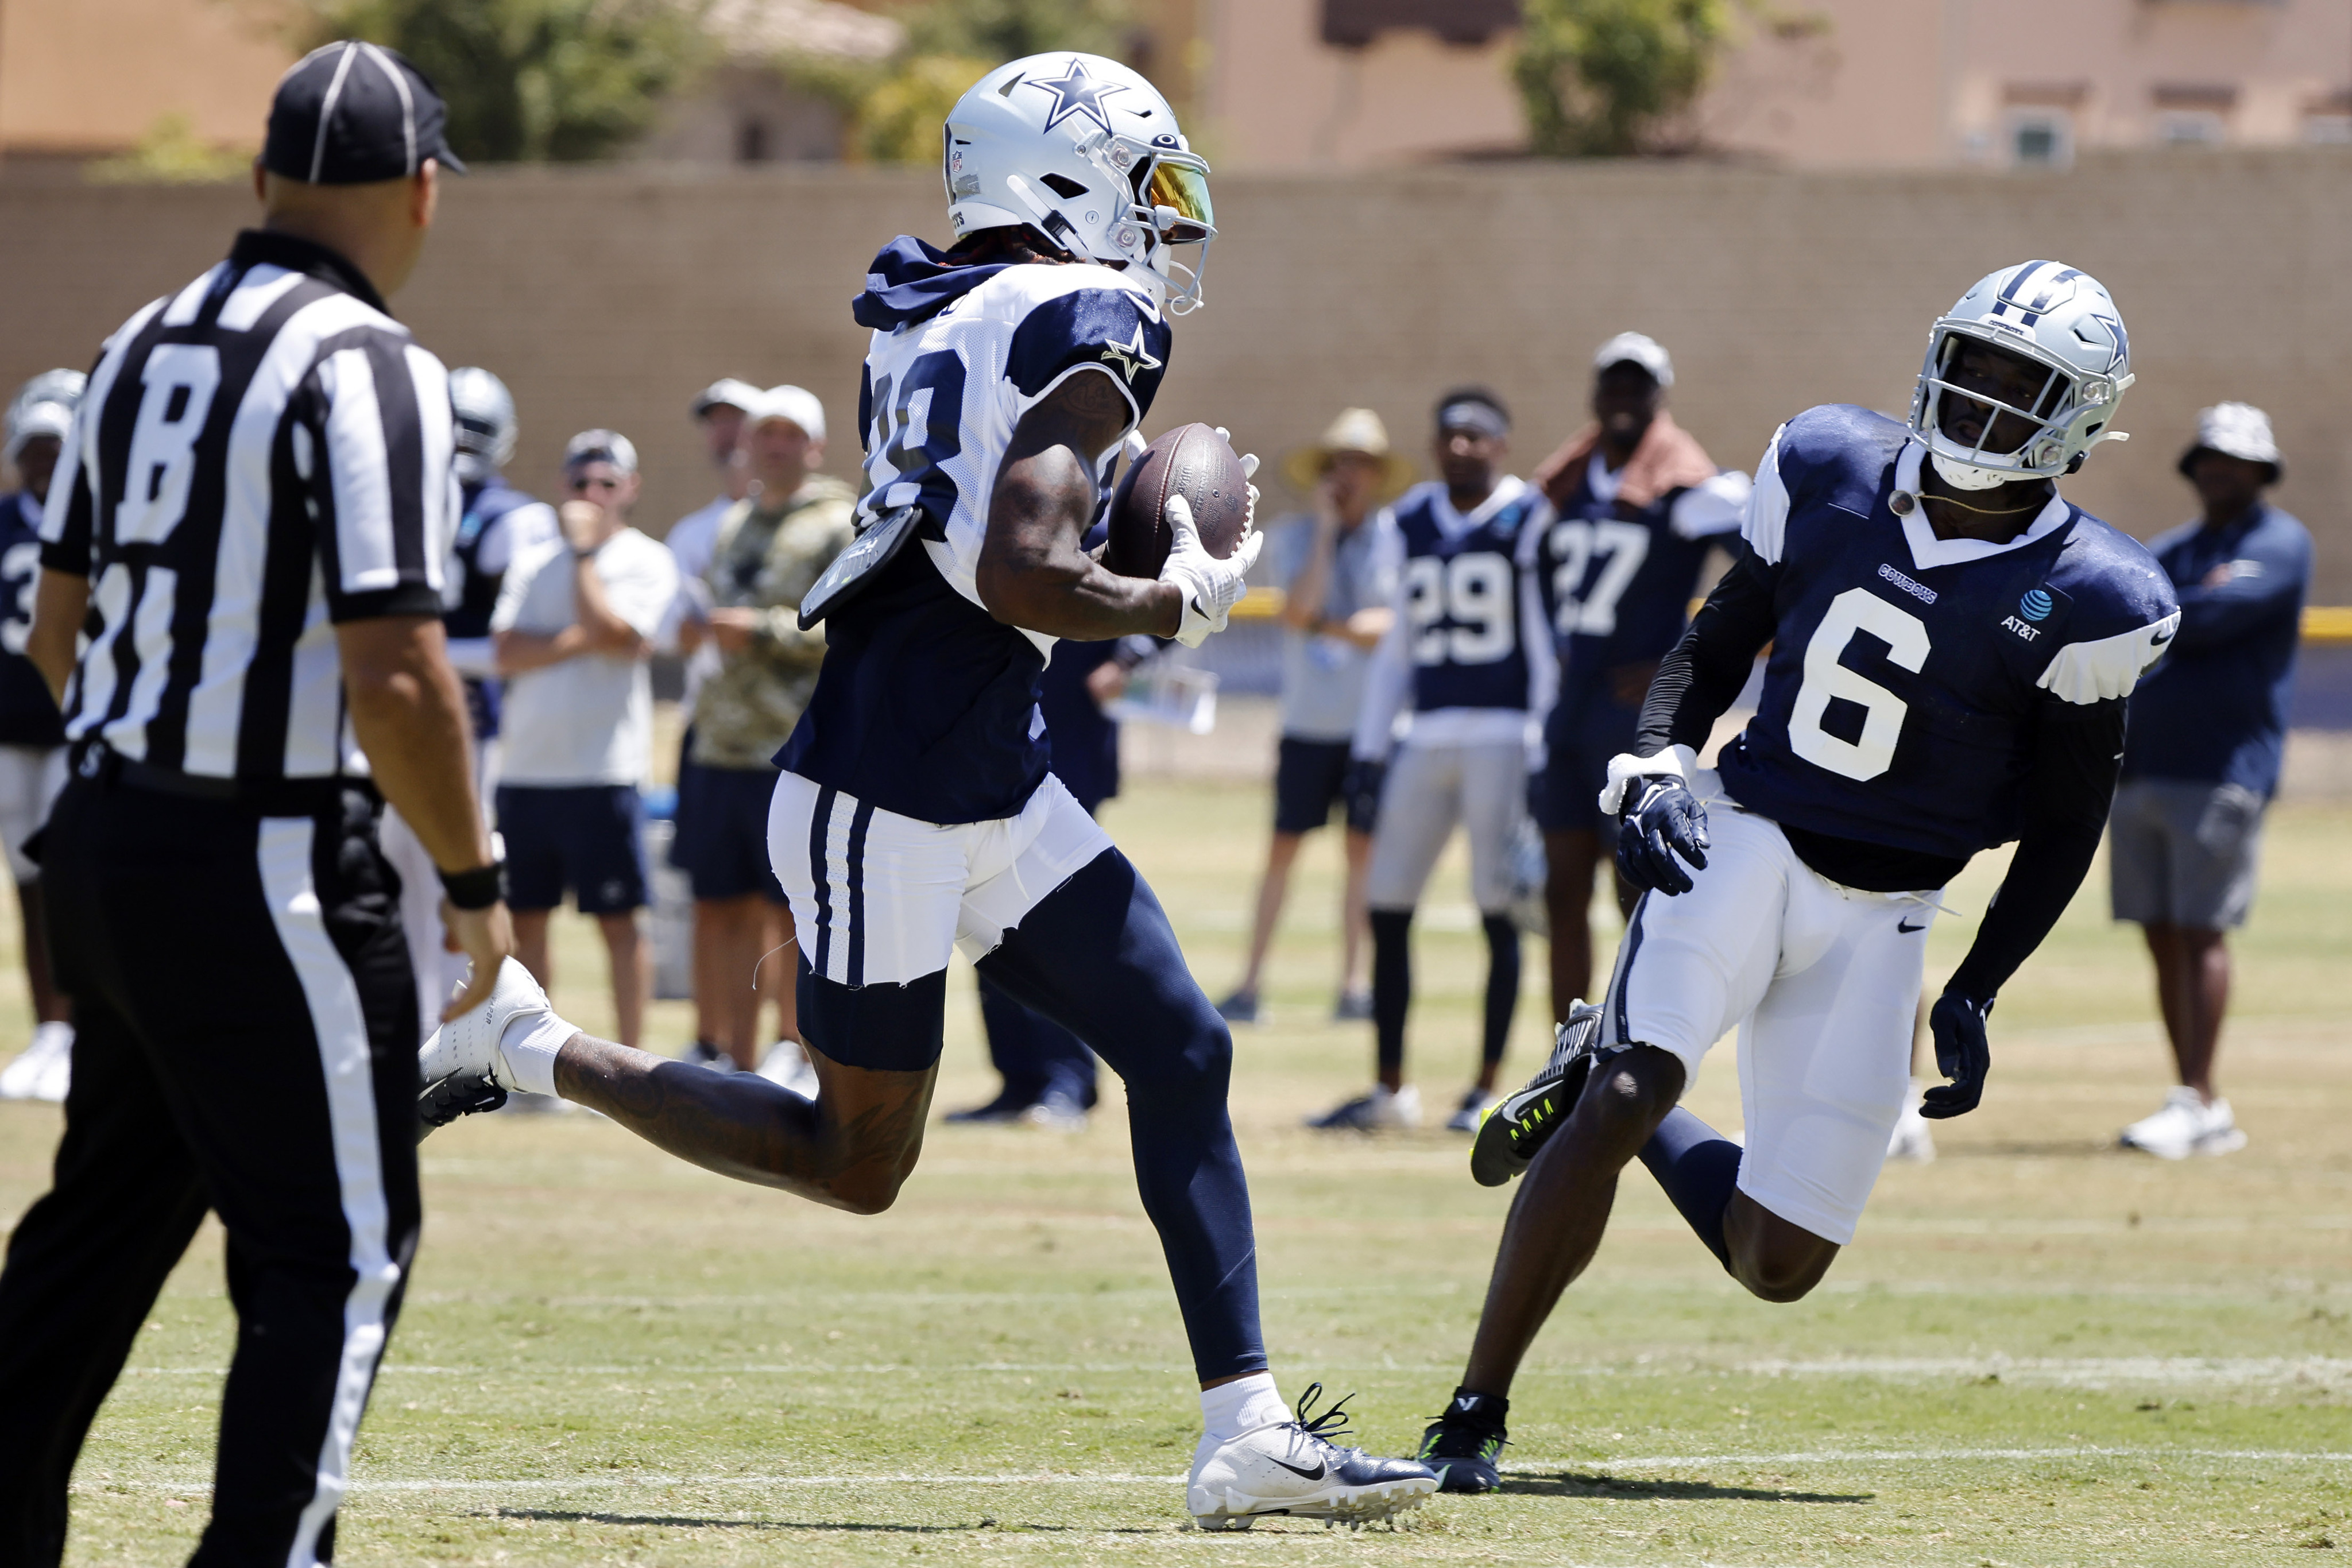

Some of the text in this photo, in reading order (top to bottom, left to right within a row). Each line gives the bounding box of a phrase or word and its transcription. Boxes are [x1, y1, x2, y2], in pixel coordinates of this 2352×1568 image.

[115, 343, 222, 545] B
[1406, 549, 1515, 667] 29
[1550, 517, 1651, 637] 27
[1878, 563, 1938, 605] COWBOYS
[2001, 615, 2041, 642] AT&T
[1787, 587, 1932, 783] 6
